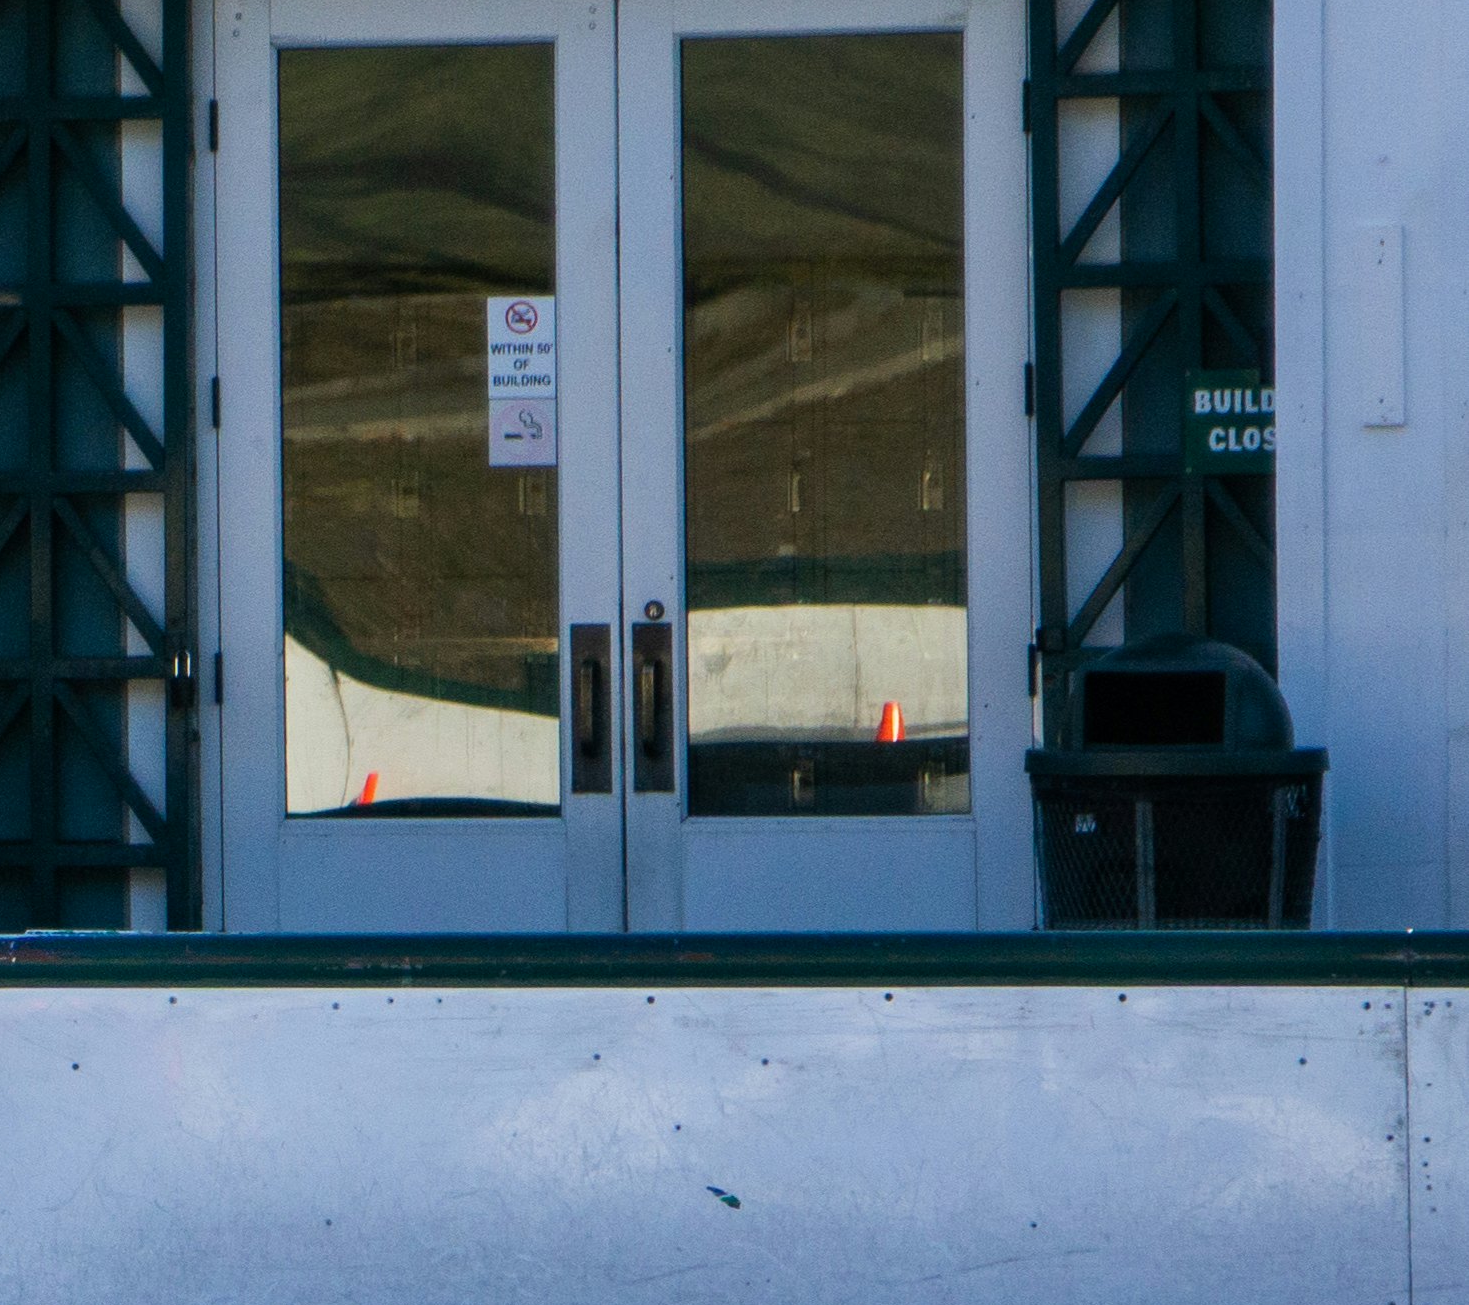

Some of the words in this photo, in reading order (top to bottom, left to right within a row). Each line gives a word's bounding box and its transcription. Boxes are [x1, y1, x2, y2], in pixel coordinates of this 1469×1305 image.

[490, 343, 533, 355] WITHIN
[513, 358, 530, 370] OF
[492, 374, 552, 387] BUILDING
